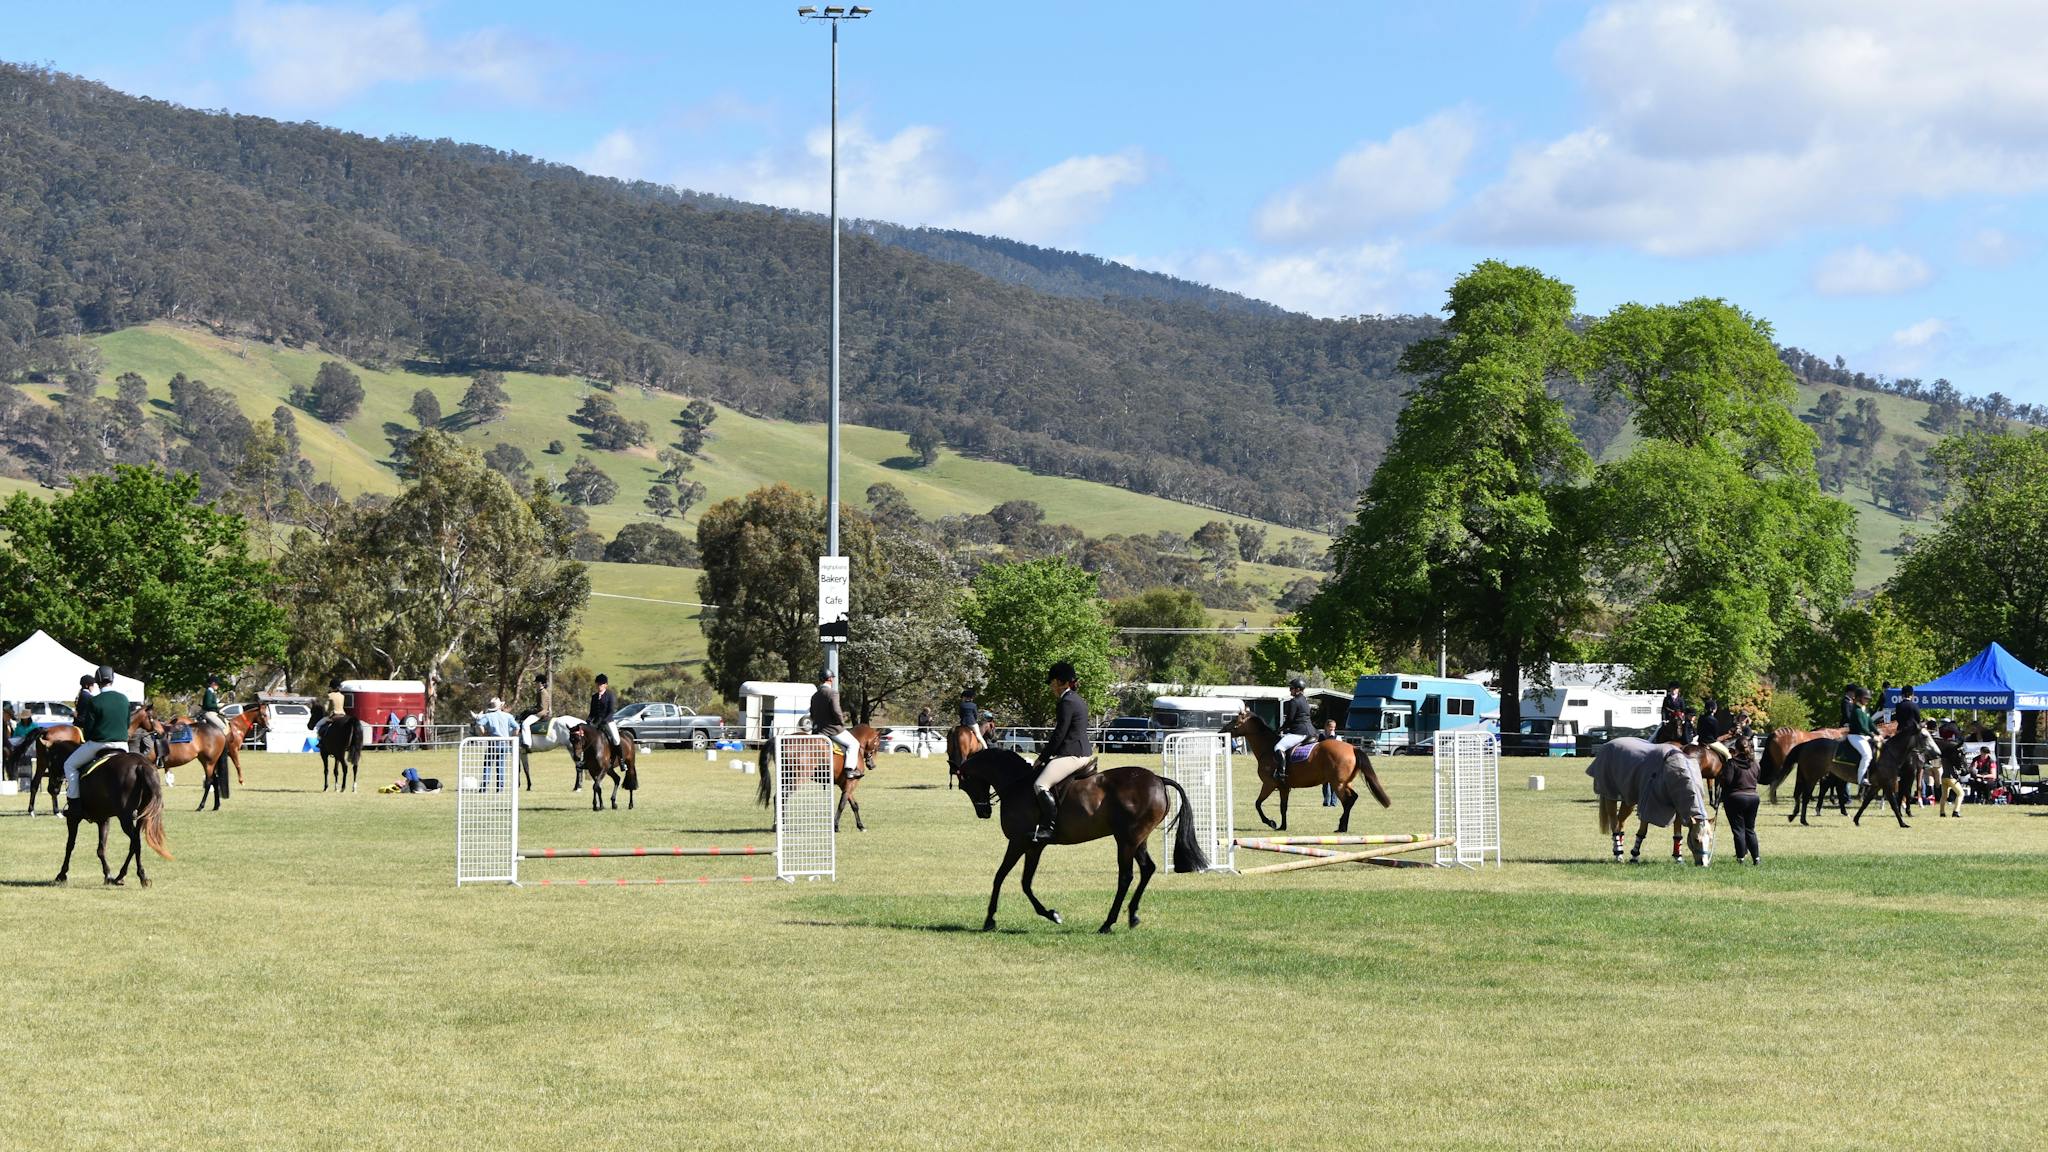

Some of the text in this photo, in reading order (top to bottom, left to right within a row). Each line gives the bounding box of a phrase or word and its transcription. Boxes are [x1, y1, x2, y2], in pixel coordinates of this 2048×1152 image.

[821, 574, 847, 585] Bakery
[825, 596, 843, 604] Cafe
[1891, 695, 2008, 705] OMO & DISTRICT SHOW
